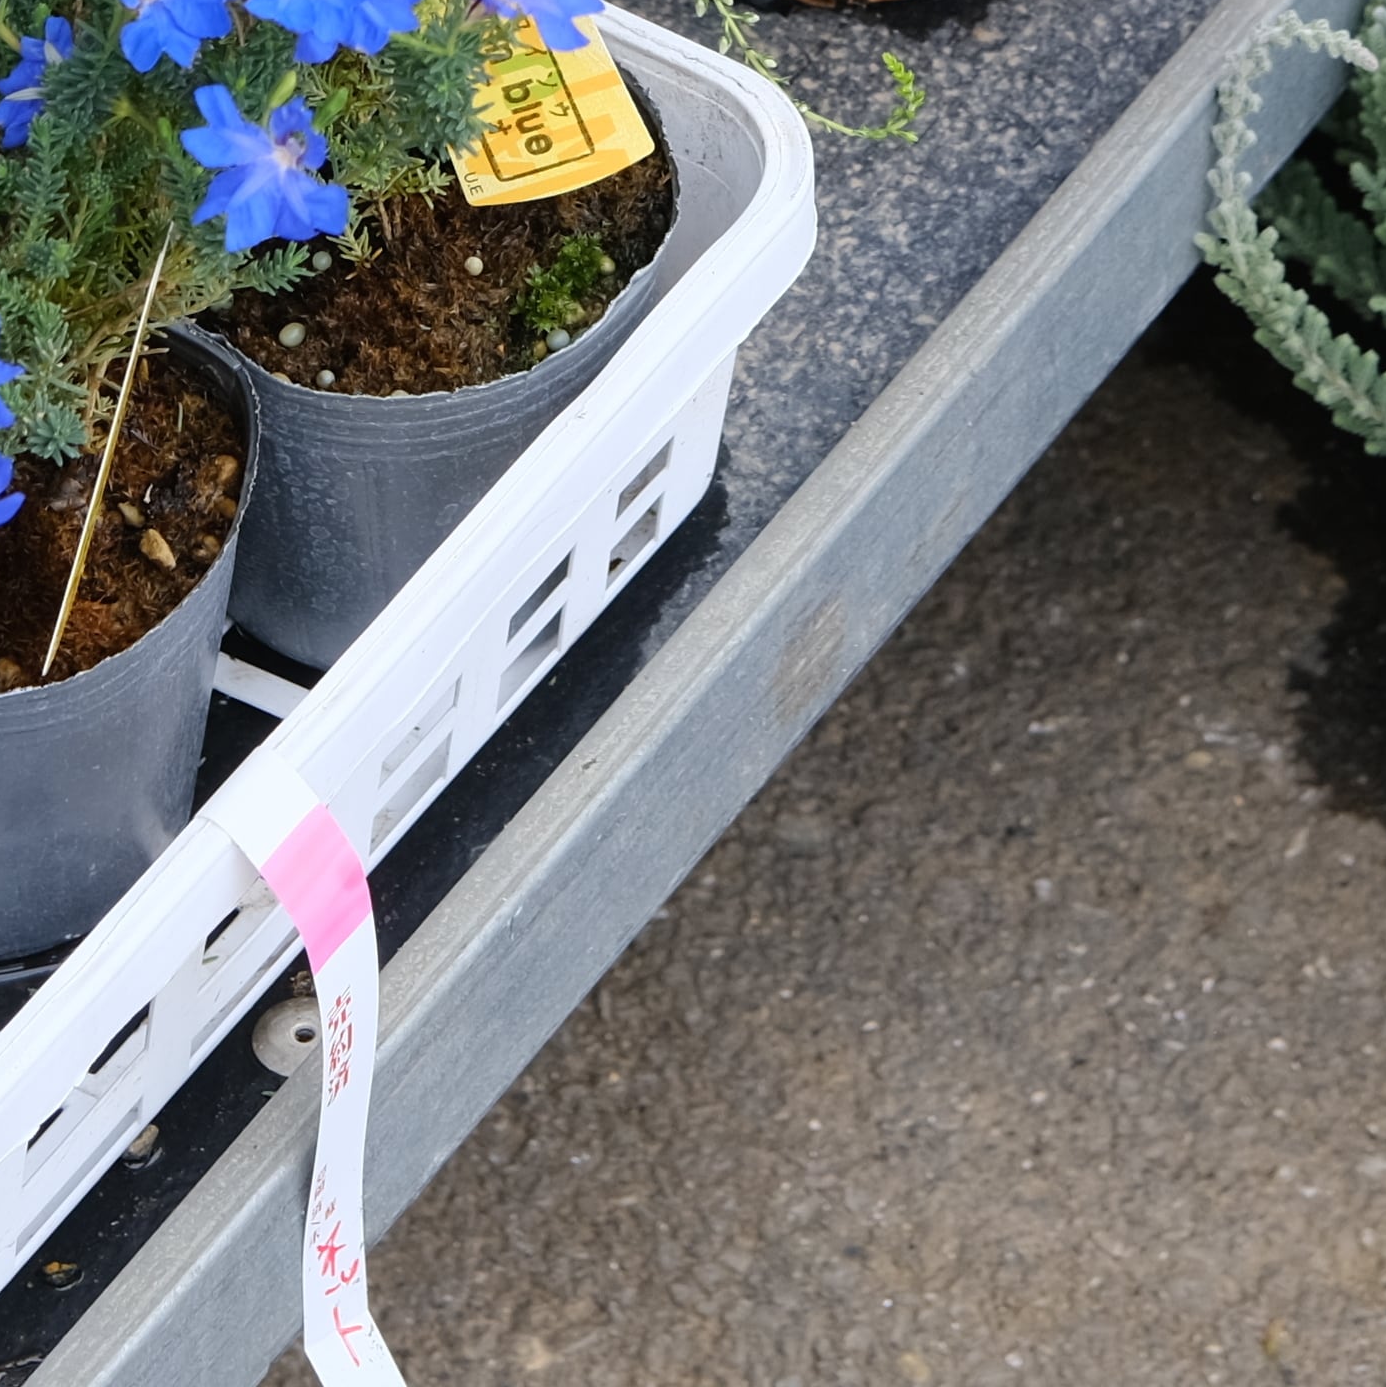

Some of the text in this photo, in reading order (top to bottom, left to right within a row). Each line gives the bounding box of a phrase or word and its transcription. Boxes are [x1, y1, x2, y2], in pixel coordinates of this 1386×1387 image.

[499, 77, 554, 157] blue
[463, 171, 484, 197] U.E
[326, 984, 353, 1108] 売約済
